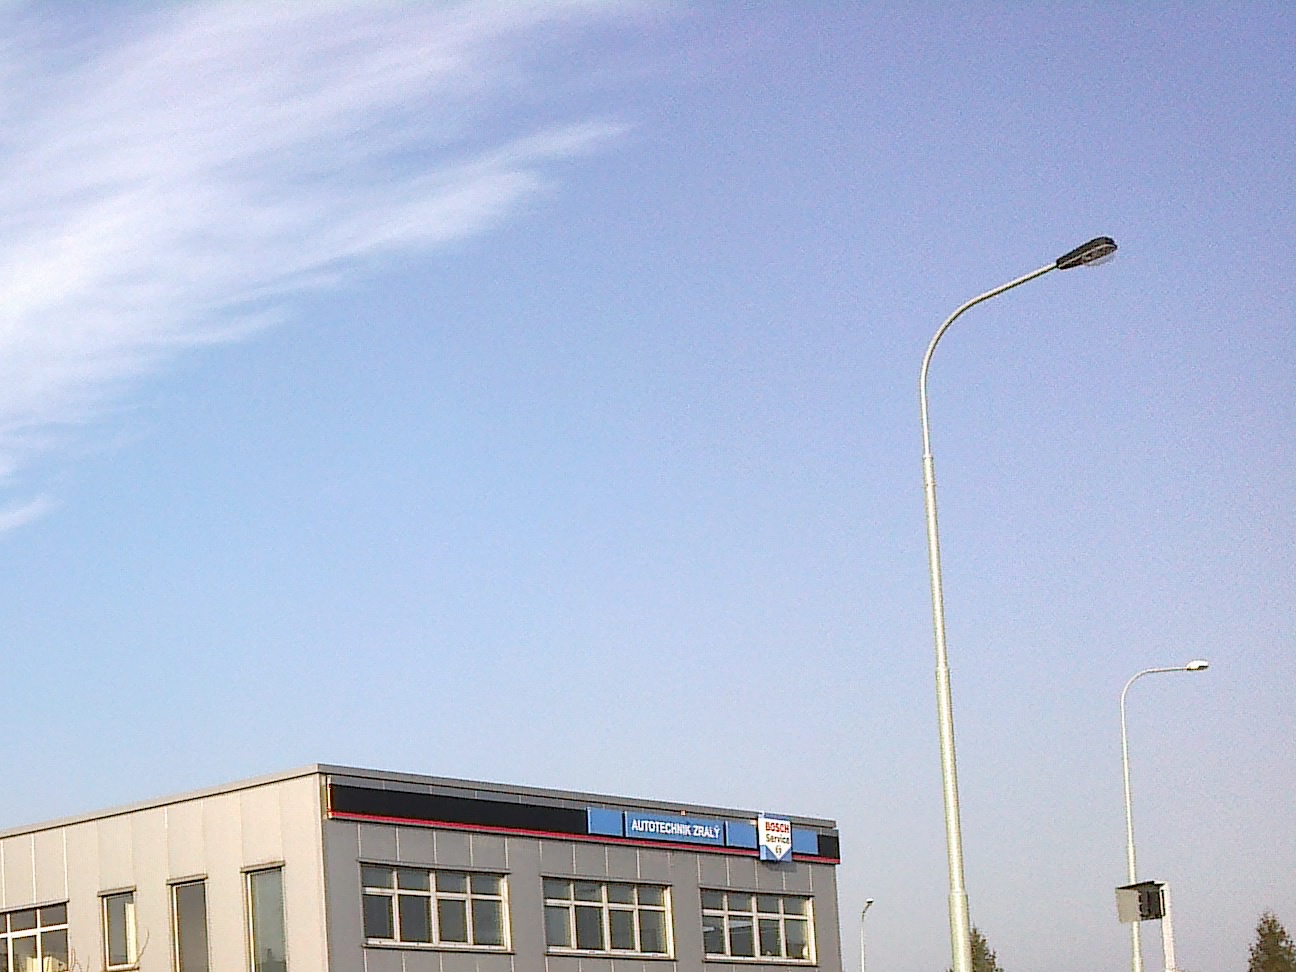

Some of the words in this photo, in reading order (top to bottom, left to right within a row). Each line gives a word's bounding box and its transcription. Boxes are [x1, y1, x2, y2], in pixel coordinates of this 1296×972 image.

[632, 819, 691, 836] AUTOTECHNIK
[693, 824, 721, 839] ZRALÝ
[765, 821, 790, 834] BOSCH
[765, 833, 791, 845] Service
